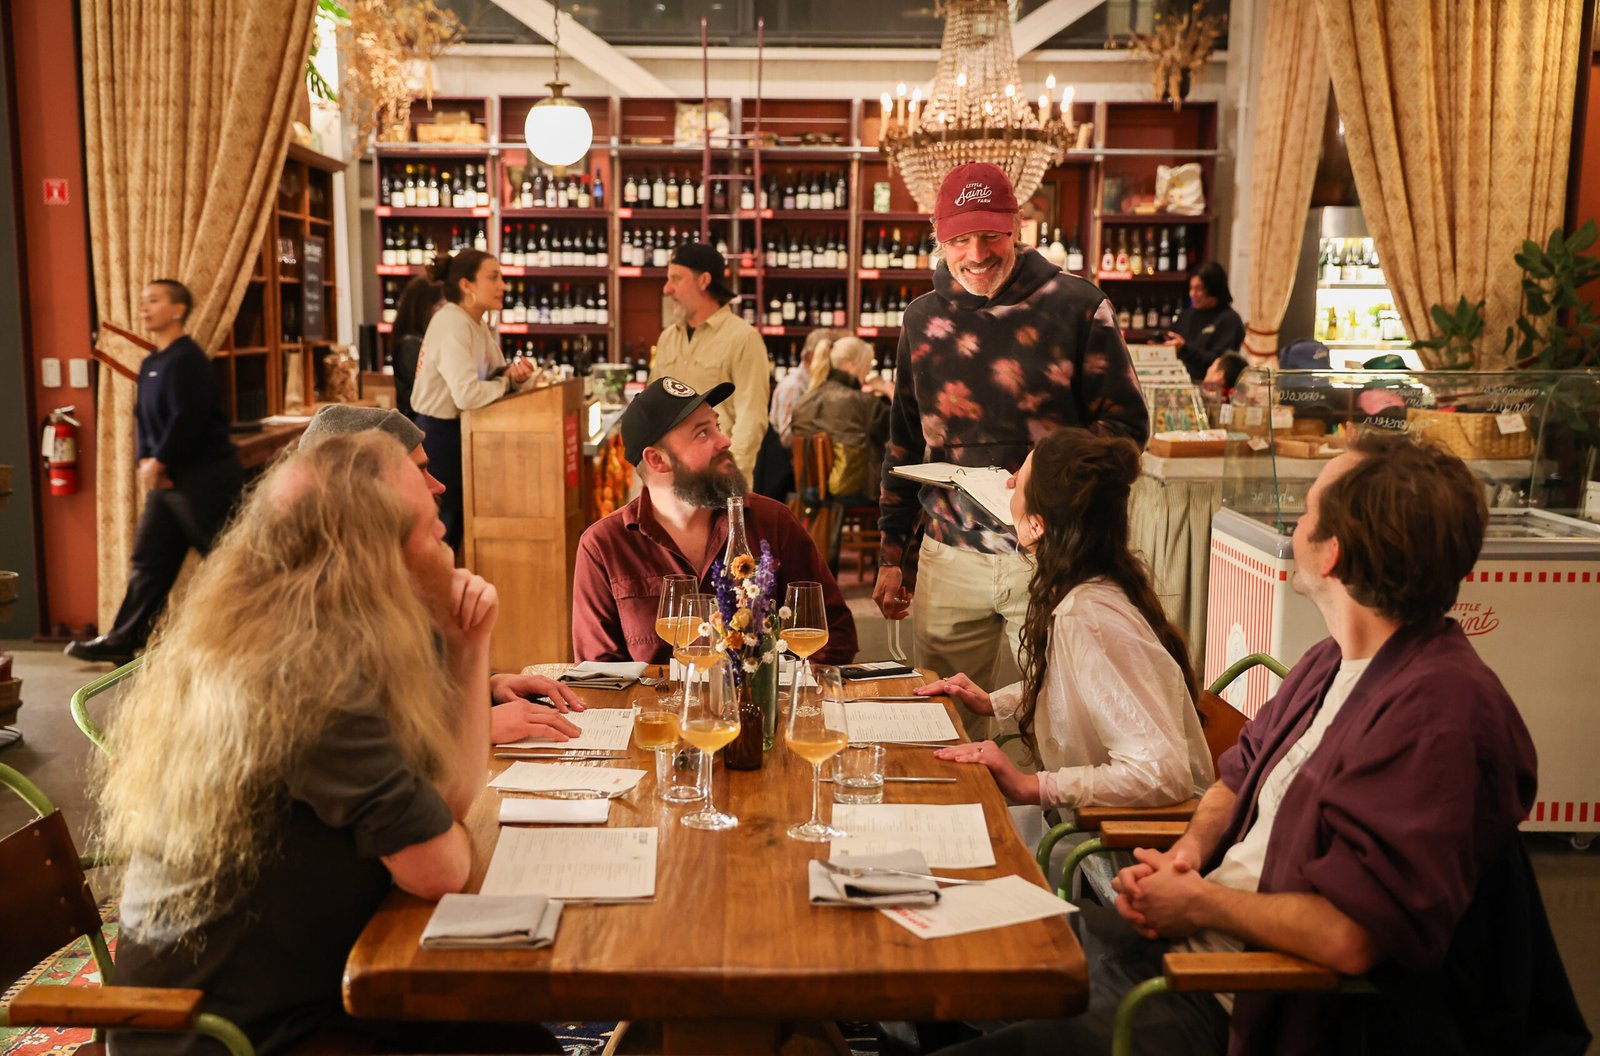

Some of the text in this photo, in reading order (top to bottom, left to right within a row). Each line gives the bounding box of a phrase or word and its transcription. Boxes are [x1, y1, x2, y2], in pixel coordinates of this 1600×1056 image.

[954, 185, 992, 206] Saint
[1453, 603, 1481, 611] ITTLE
[1460, 606, 1500, 637] int
